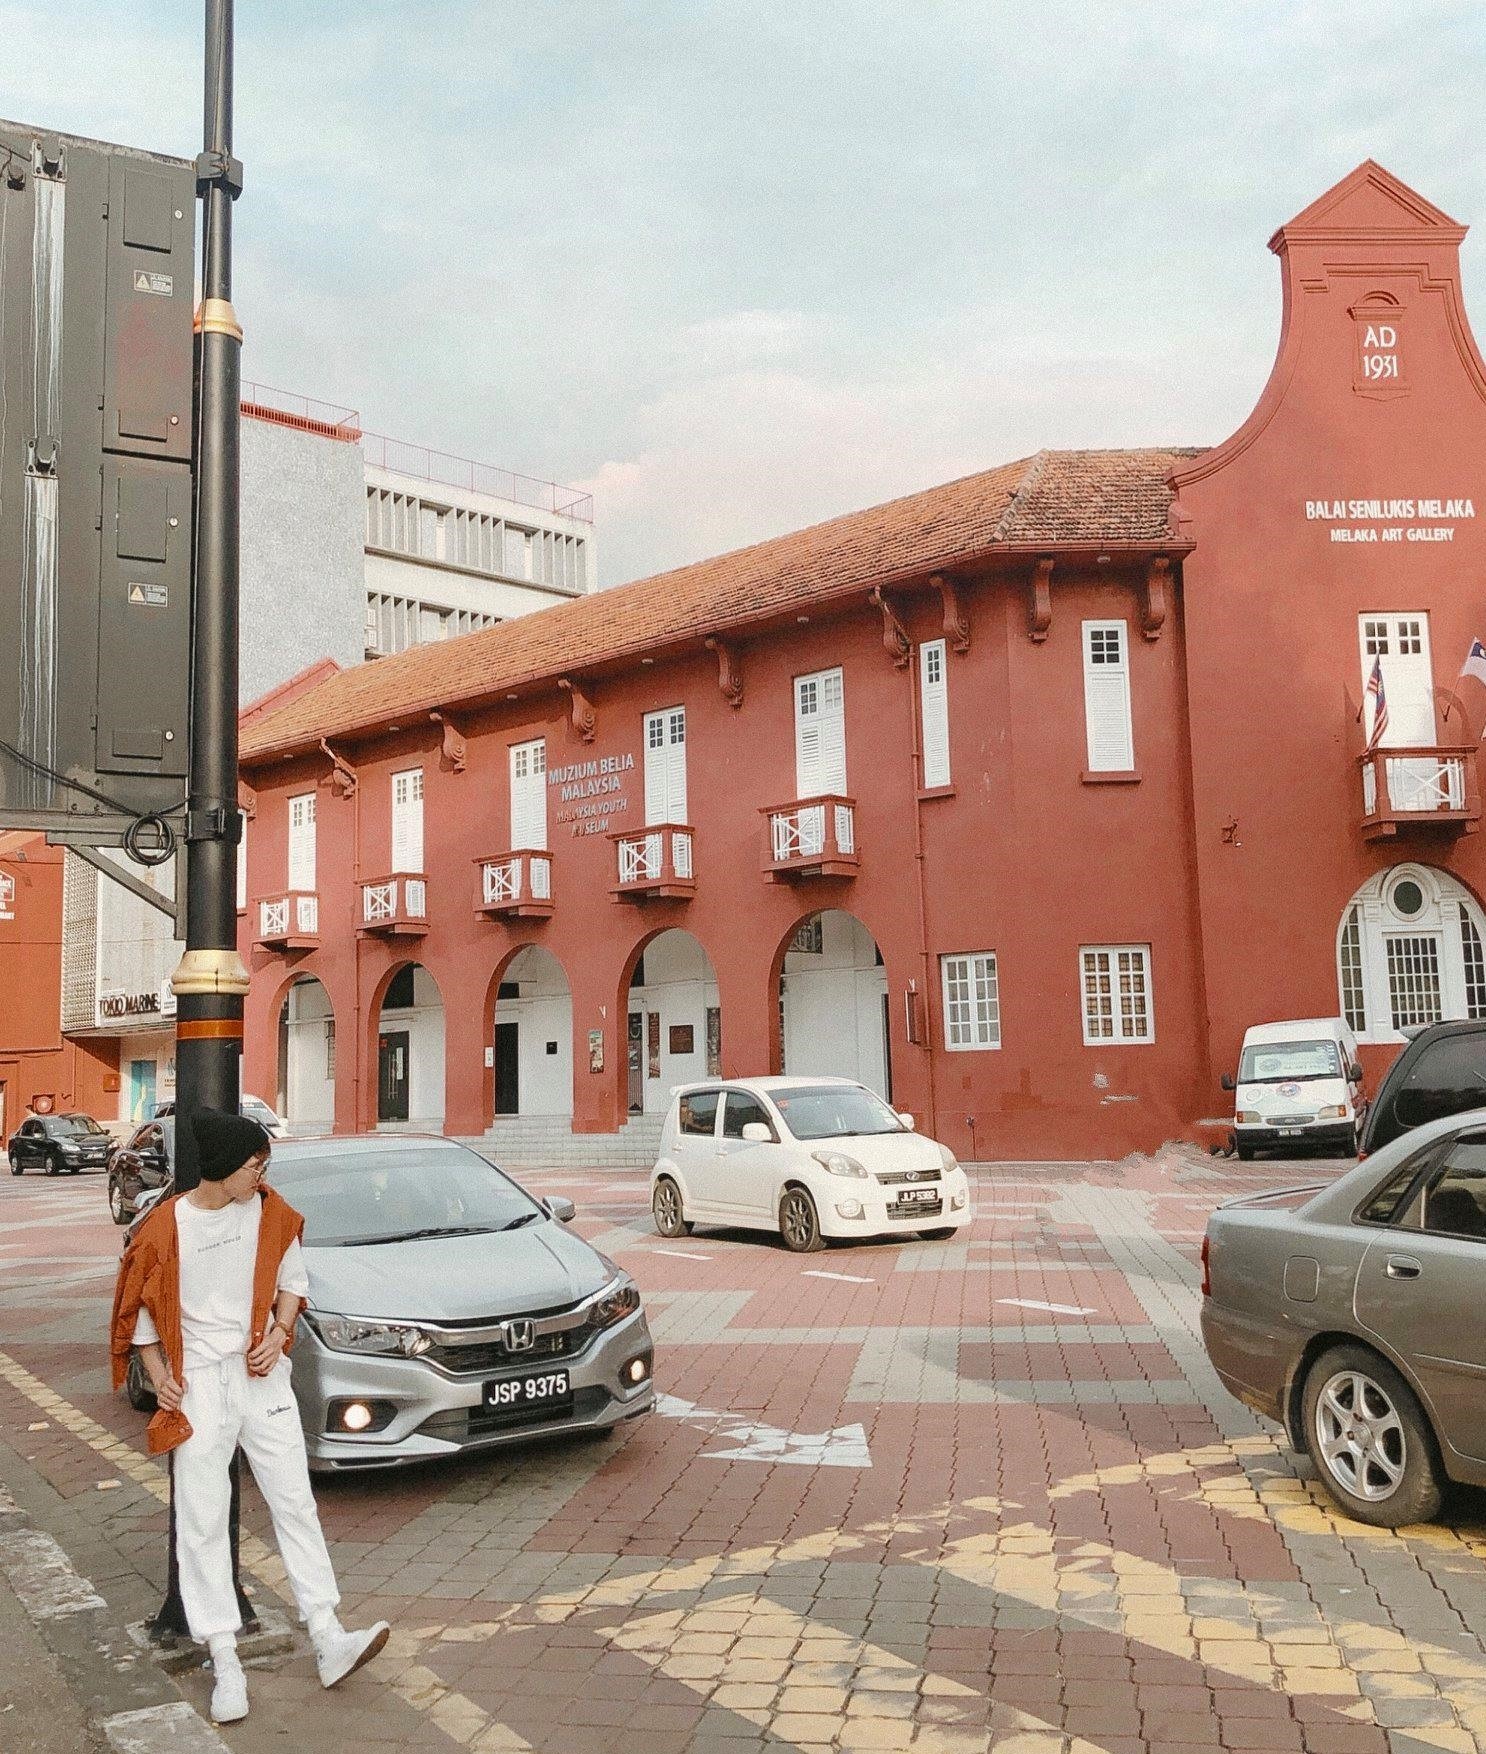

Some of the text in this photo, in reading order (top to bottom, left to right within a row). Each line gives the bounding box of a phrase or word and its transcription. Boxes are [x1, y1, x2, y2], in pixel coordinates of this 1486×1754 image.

[1363, 325, 1397, 349] AD
[1363, 354, 1399, 380] 1931
[1305, 500, 1347, 520] BALAI
[1418, 499, 1475, 519] MELAKA
[1330, 528, 1455, 542] MELAKA ART GALLERY
[549, 753, 634, 784] MUZIUM BELIA
[561, 775, 620, 802] MALAYSIA
[599, 799, 628, 815] YOUTH
[488, 1373, 567, 1406] JSP 9375
